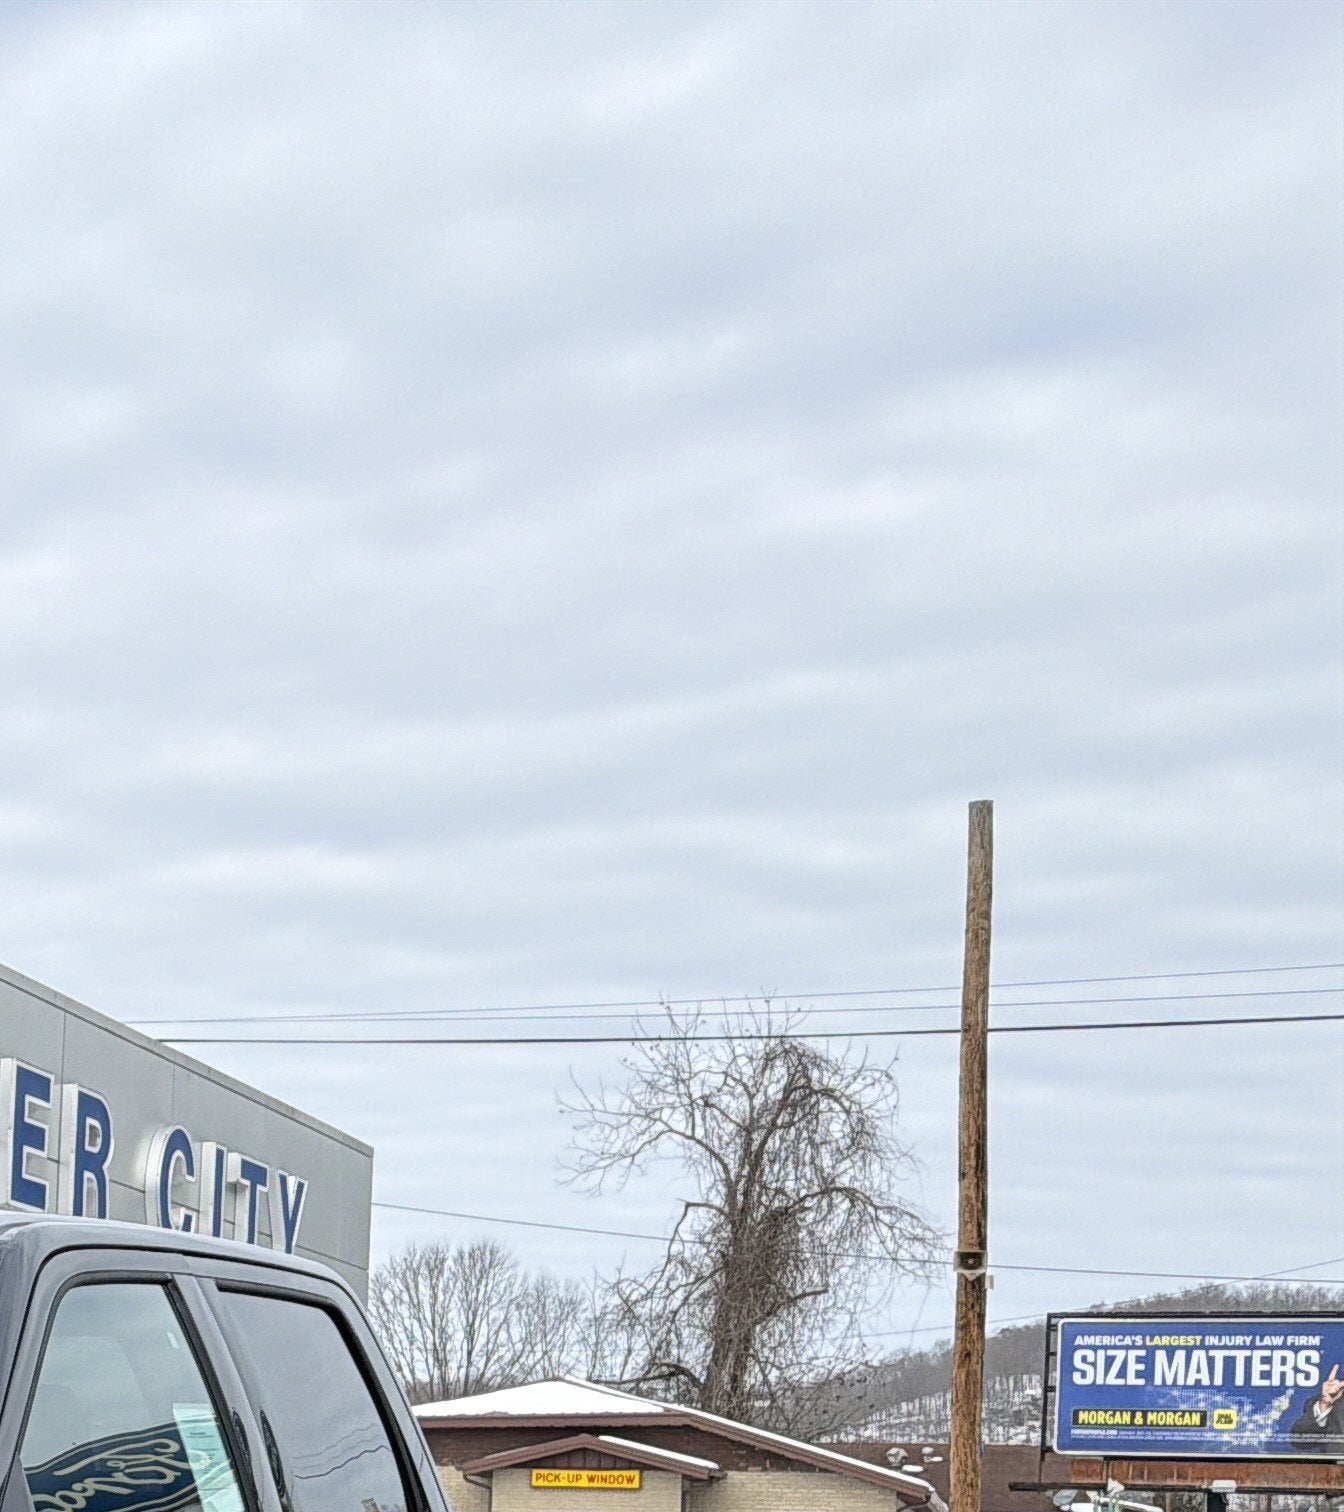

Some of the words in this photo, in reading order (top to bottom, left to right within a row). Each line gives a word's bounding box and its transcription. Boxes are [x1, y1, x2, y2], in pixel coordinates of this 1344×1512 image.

[148, 1125, 308, 1254] CITY
[1074, 1335, 1143, 1346] AMERICA'S
[1145, 1335, 1202, 1346] LARGEST
[1204, 1335, 1253, 1346] INJURY
[1255, 1335, 1285, 1346] LAW
[1072, 1349, 1147, 1386] SIZE
[1153, 1349, 1320, 1387] MATTERS
[1078, 1411, 1132, 1425] MORGAN
[1134, 1411, 1144, 1425] &
[1146, 1411, 1201, 1426] MORGAN
[534, 1472, 583, 1484] PICK-UP
[586, 1473, 636, 1485] WINDOW
